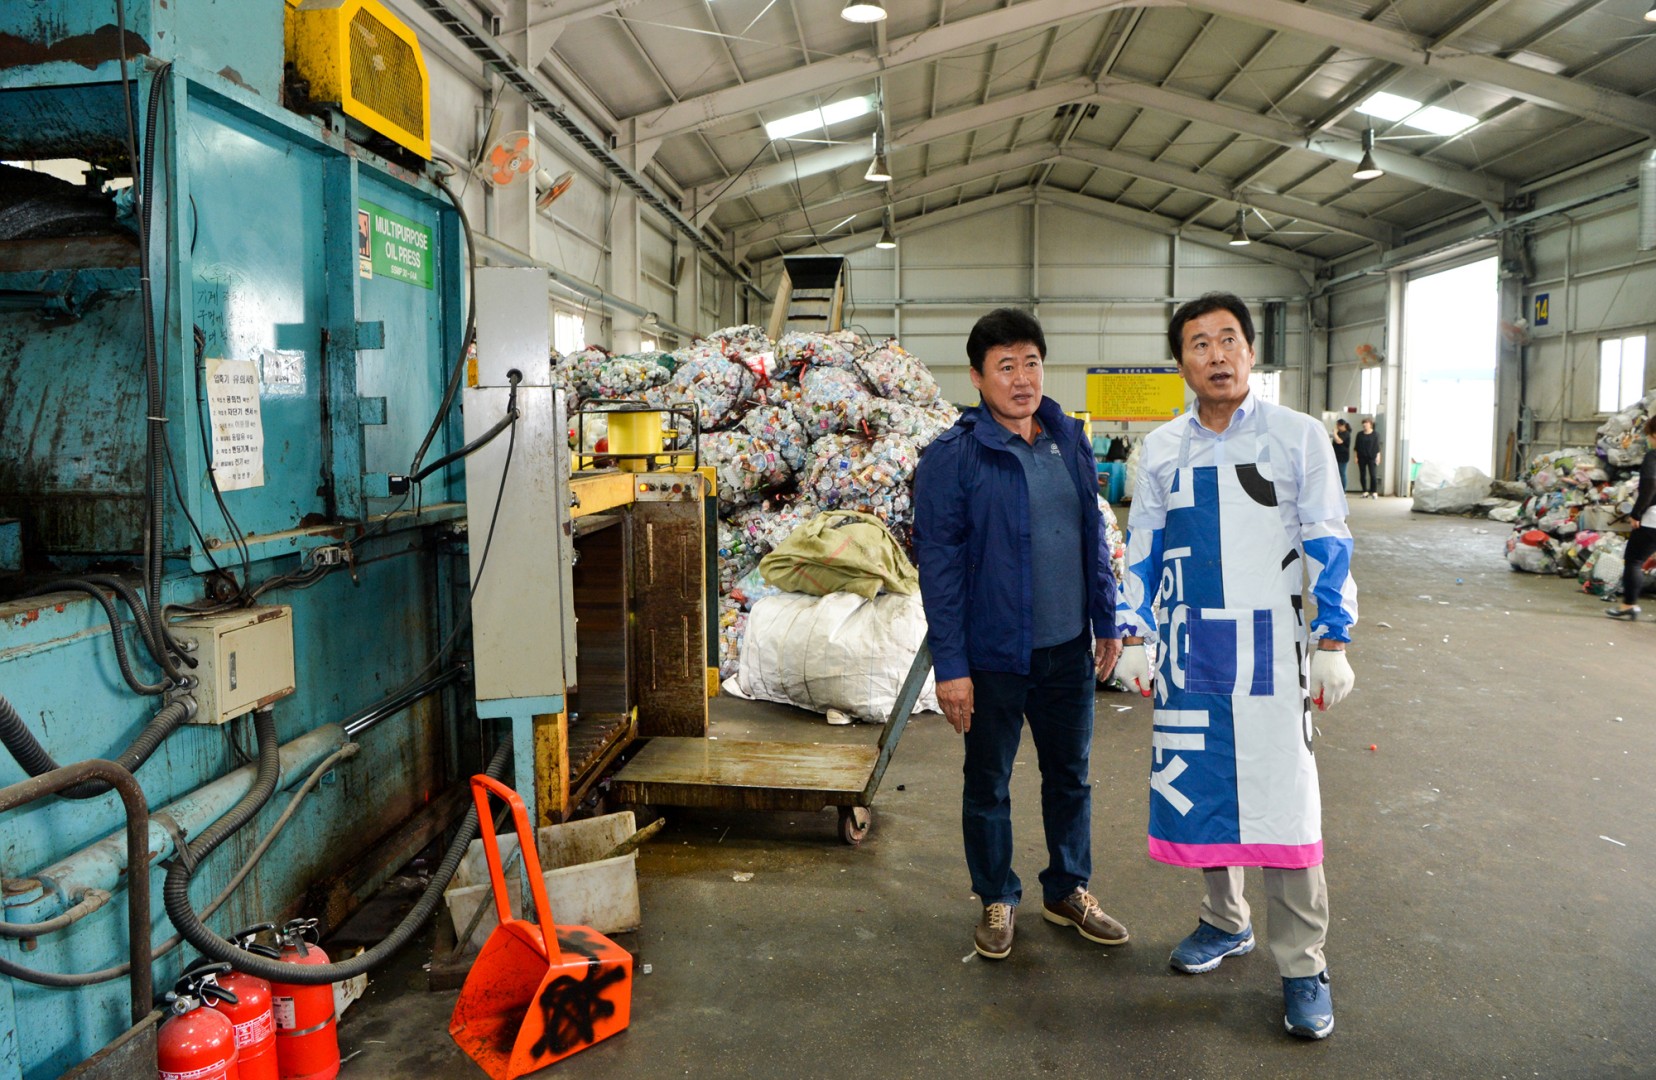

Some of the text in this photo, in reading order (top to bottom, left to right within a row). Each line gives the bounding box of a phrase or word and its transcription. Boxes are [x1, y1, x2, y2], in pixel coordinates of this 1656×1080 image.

[375, 215, 428, 250] MULTIPURPOSE
[385, 241, 421, 268] OIL PRESS
[197, 289, 219, 306] 기계
[1535, 299, 1548, 320] 14
[214, 374, 254, 384] 압축기 유의사항
